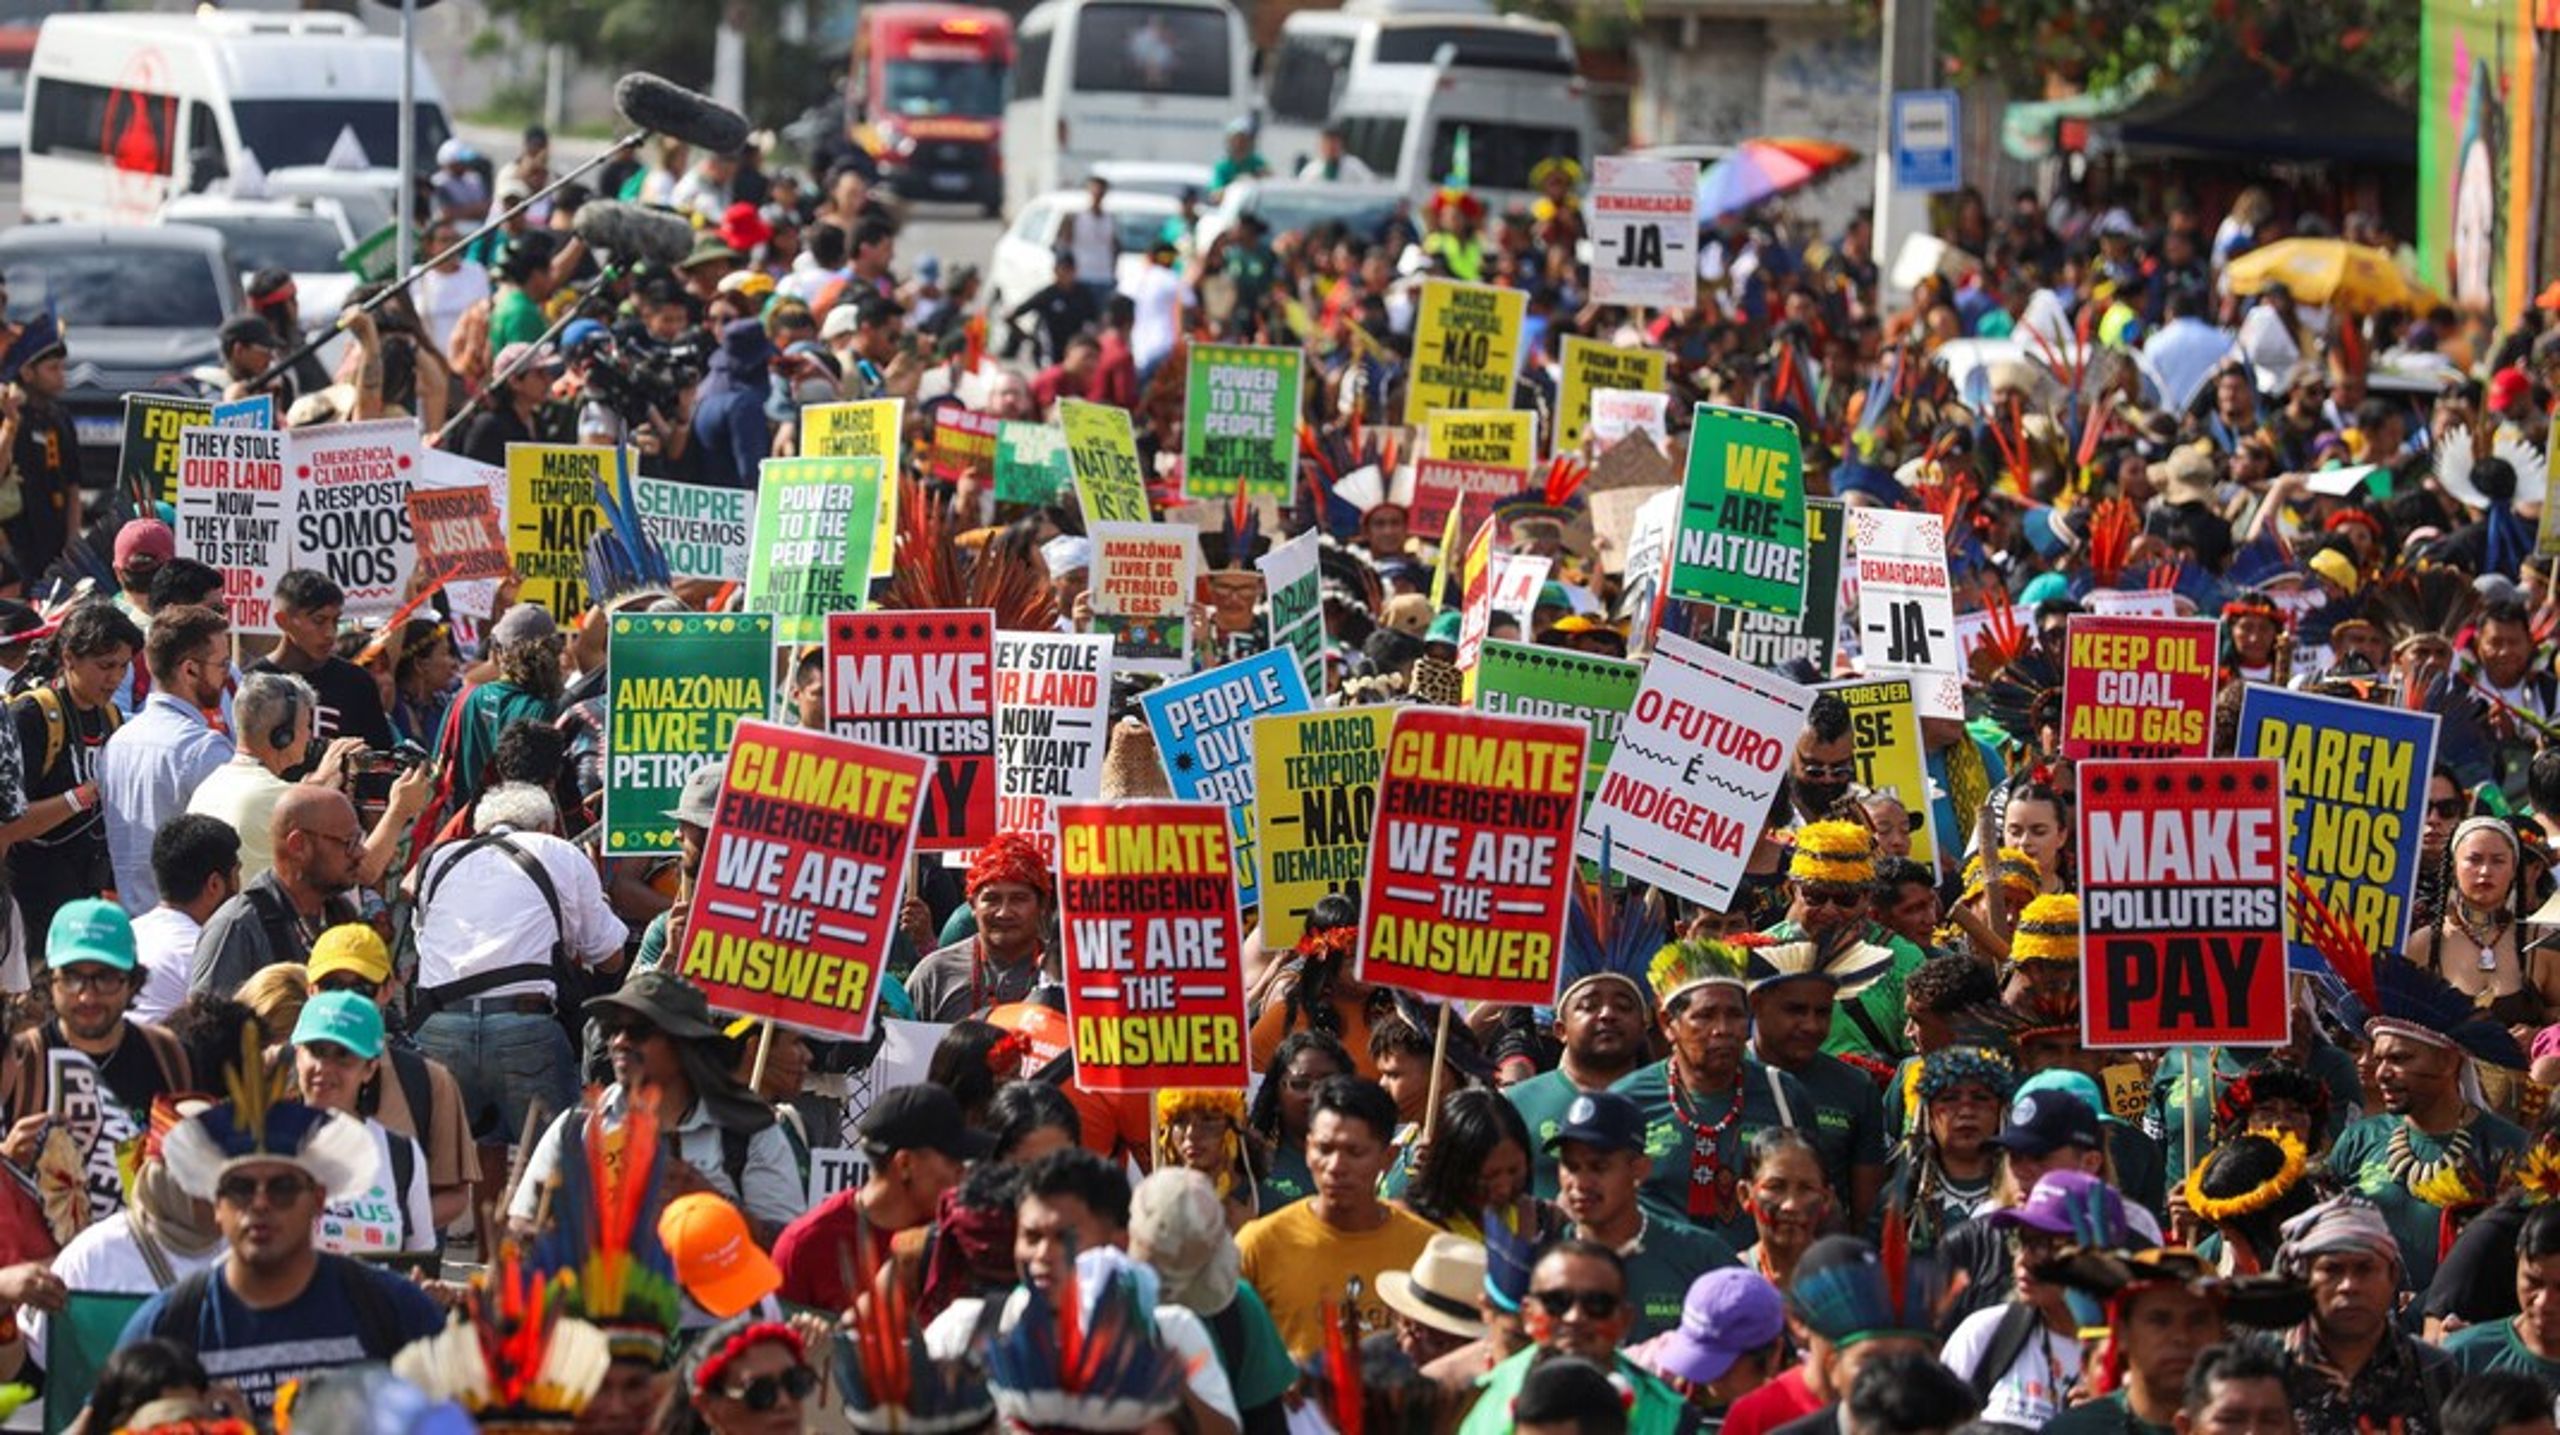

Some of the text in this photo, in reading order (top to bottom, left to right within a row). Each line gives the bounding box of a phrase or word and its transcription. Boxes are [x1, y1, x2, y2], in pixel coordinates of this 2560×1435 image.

[1209, 365, 1279, 391] POWER
[830, 408, 875, 433] MARCO
[1211, 389, 1276, 414] TO THE
[1205, 413, 1276, 439] PEOPLE
[1443, 423, 1516, 441] FROM THE
[184, 433, 280, 461] THEY STOLE
[541, 452, 600, 480] MARCO
[1071, 446, 1141, 487] NATURE
[1204, 437, 1275, 460] NOT THE
[184, 458, 283, 492] OUR LAND
[1190, 457, 1287, 481] POLLUTERS
[1723, 441, 1790, 499] WE
[215, 491, 255, 516] NOW
[296, 479, 416, 512] A RESPOSTA
[637, 480, 745, 523] SEMPRE
[779, 484, 854, 511] POWER
[183, 516, 280, 543] THEY WANT
[429, 517, 492, 553] JUSTA
[778, 511, 849, 539] TO THE
[1717, 493, 1783, 539] ARE
[194, 542, 270, 567] TO STEAL
[661, 541, 723, 576] AQUI
[770, 540, 849, 567] PEOPLE
[1104, 540, 1183, 560] AMAZÔNIA
[1110, 561, 1174, 577] LIVRE DE
[1680, 527, 1803, 585] NATURE
[768, 567, 845, 593] NOT THE
[1104, 578, 1179, 596] PETRÓLEO
[1860, 559, 1946, 589] DEMARCAÇÃO
[995, 642, 1099, 673] EY STOLE
[1727, 630, 1824, 671] UTURE
[2071, 632, 2211, 680] KEEP OIL,
[615, 674, 764, 710] AMAZÔNIA
[835, 652, 988, 716] MAKE
[1025, 673, 1098, 710] LAND
[1163, 665, 1287, 741] PEOPLE
[1841, 681, 1911, 705] FOREVER
[2096, 669, 2185, 712] COAL,
[613, 711, 710, 753] LIVRE
[1002, 706, 1055, 737] NOW
[1299, 715, 1375, 755] MARCO
[1635, 687, 1784, 774] O FUTURO
[2070, 705, 2204, 746] AND GAS
[612, 750, 725, 790] PETRÓ
[1021, 738, 1092, 770] WANT
[1284, 748, 1387, 790] TEMPORA
[1389, 730, 1580, 795] CLIMATE
[1681, 752, 1704, 786] É
[2257, 717, 2416, 812] PAREM
[728, 741, 918, 825] CLIMATE
[1004, 766, 1074, 797] STEAL
[1385, 779, 1574, 832] EMERGENCY
[1599, 770, 1747, 860] INDÍGENA
[719, 793, 906, 862] EMERGENCY
[2088, 808, 2275, 884] MAKE
[2306, 802, 2401, 885] NOS
[1063, 823, 1229, 876] CLIMATE
[1386, 819, 1557, 888] WE ARE
[714, 833, 888, 918] WE ARE
[1064, 876, 1230, 914] EMERGENCY
[760, 901, 817, 944] THE
[1439, 882, 1493, 923] THE
[2089, 888, 2277, 930] POLLUTERS
[1071, 917, 1227, 971] WE ARE
[1368, 912, 1553, 983] ANSWER
[682, 927, 871, 1013] ANSWER
[2105, 937, 2263, 1031] PAY
[1121, 975, 1177, 1010] THE
[1077, 1014, 1241, 1066] ANSWER
